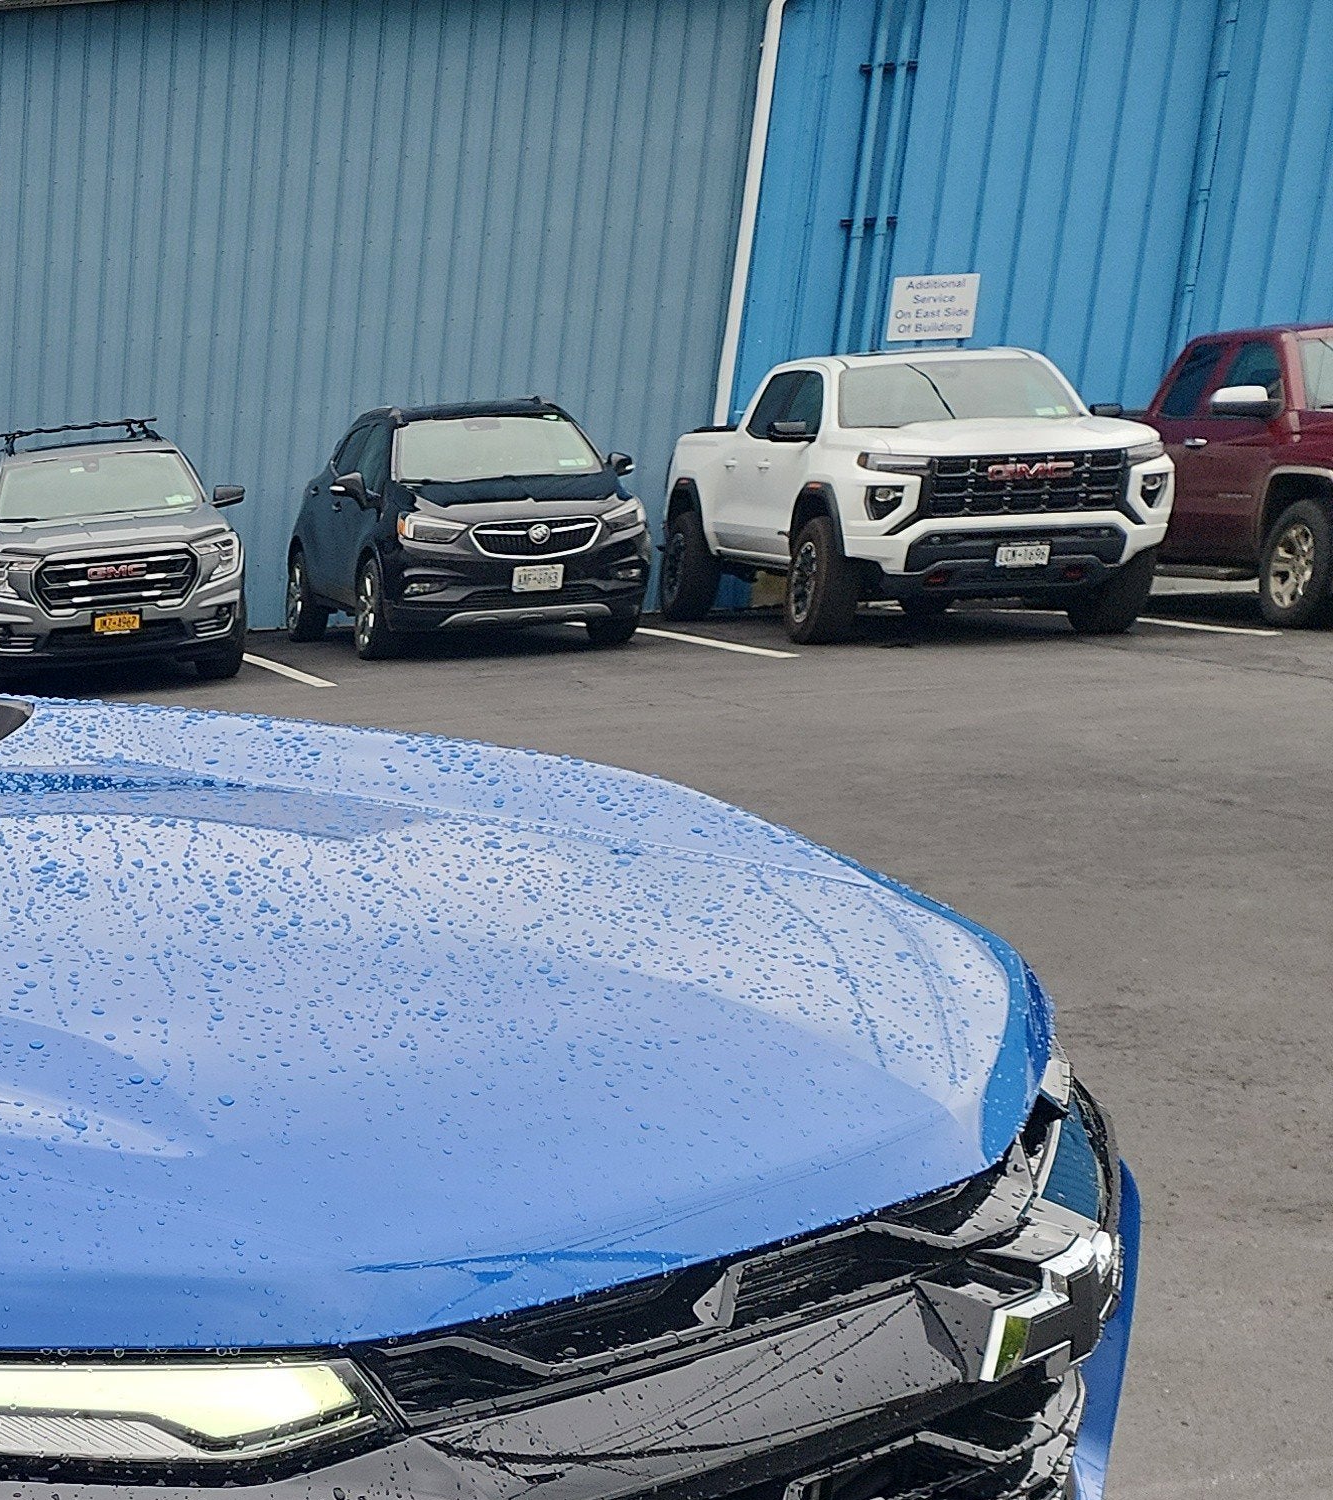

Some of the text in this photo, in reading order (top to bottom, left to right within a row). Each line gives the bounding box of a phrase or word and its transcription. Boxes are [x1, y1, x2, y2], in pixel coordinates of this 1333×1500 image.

[906, 278, 966, 290] Additional
[913, 294, 956, 304] Service
[895, 307, 969, 319] On East Side
[898, 322, 963, 334] Of Building
[988, 461, 1075, 481] GMC
[87, 563, 148, 580] GMC
